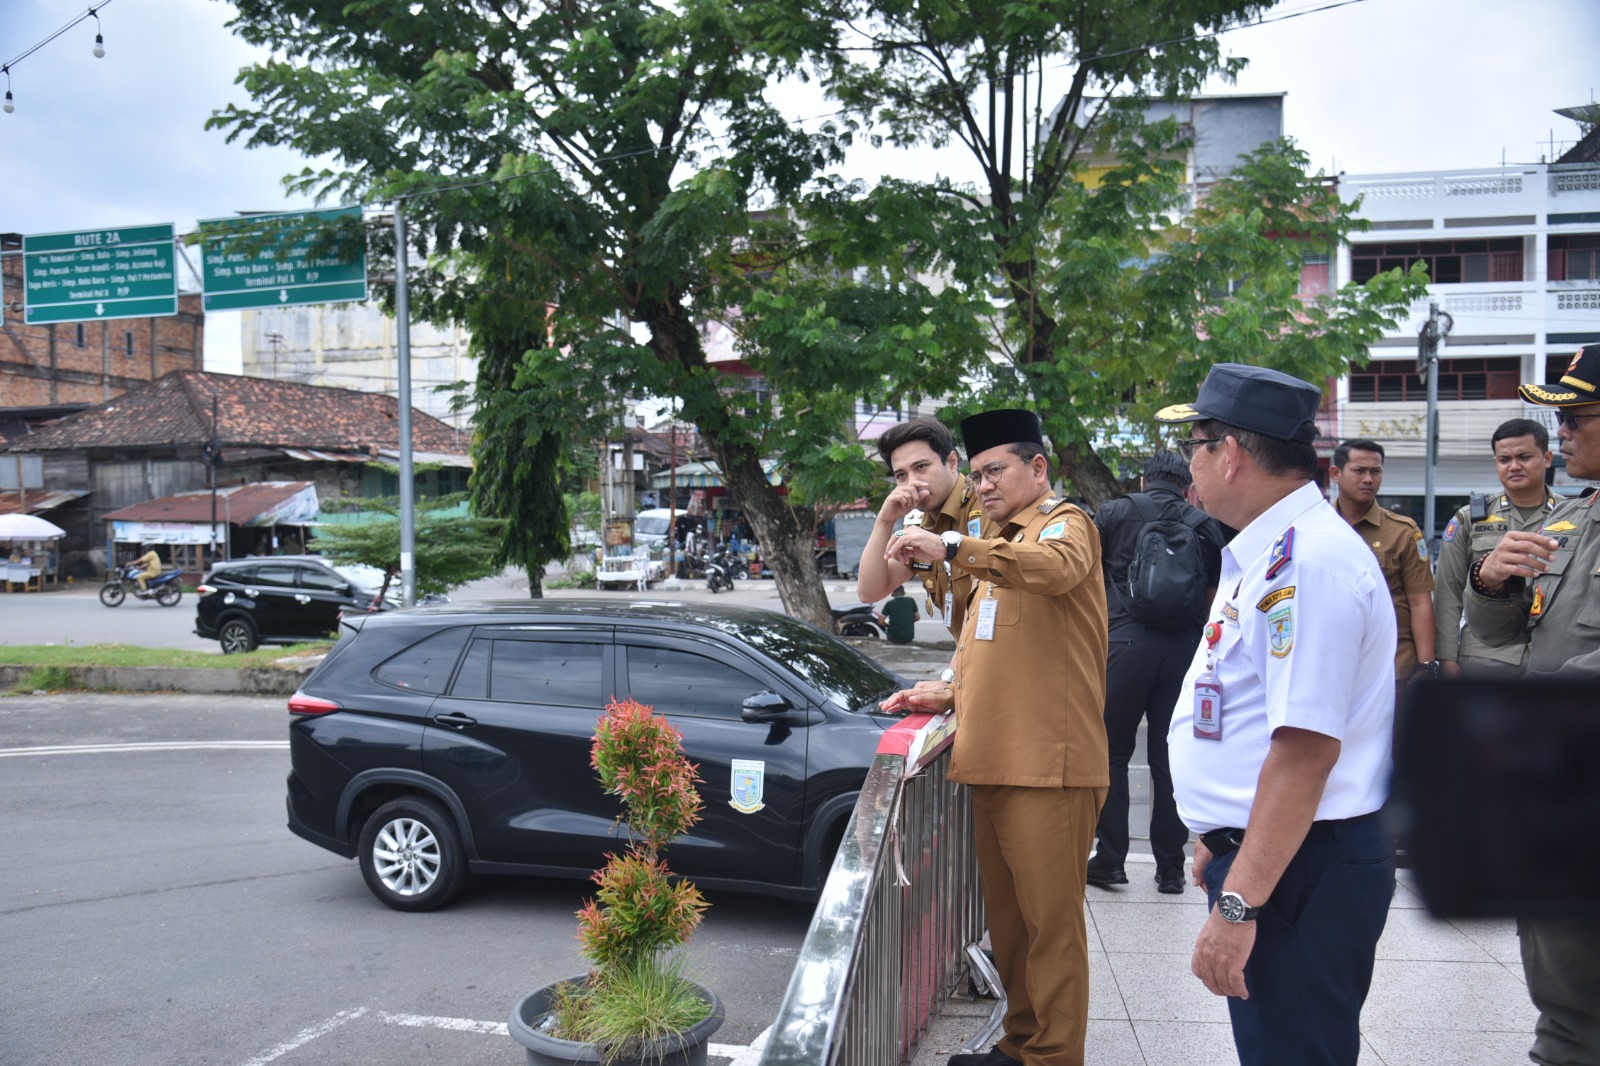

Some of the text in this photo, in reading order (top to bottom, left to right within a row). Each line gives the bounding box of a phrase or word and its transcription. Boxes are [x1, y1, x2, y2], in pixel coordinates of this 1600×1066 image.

[75, 232, 120, 246] RUTE 2A
[80, 252, 96, 262] Simp.
[115, 249, 131, 258] Simp.
[207, 254, 226, 265] Simp.
[33, 269, 49, 277] Simp.
[115, 262, 131, 271] Simp.
[214, 266, 234, 277] Simp.
[234, 264, 251, 275] Kota
[252, 263, 269, 273] Baru
[276, 262, 296, 272] Simp.
[62, 279, 77, 288] Simp.
[111, 275, 126, 284] Simp.
[143, 272, 172, 281] Pertamina
[245, 272, 319, 287] Terminal Pal X P/P
[70, 290, 93, 299] Terminal
